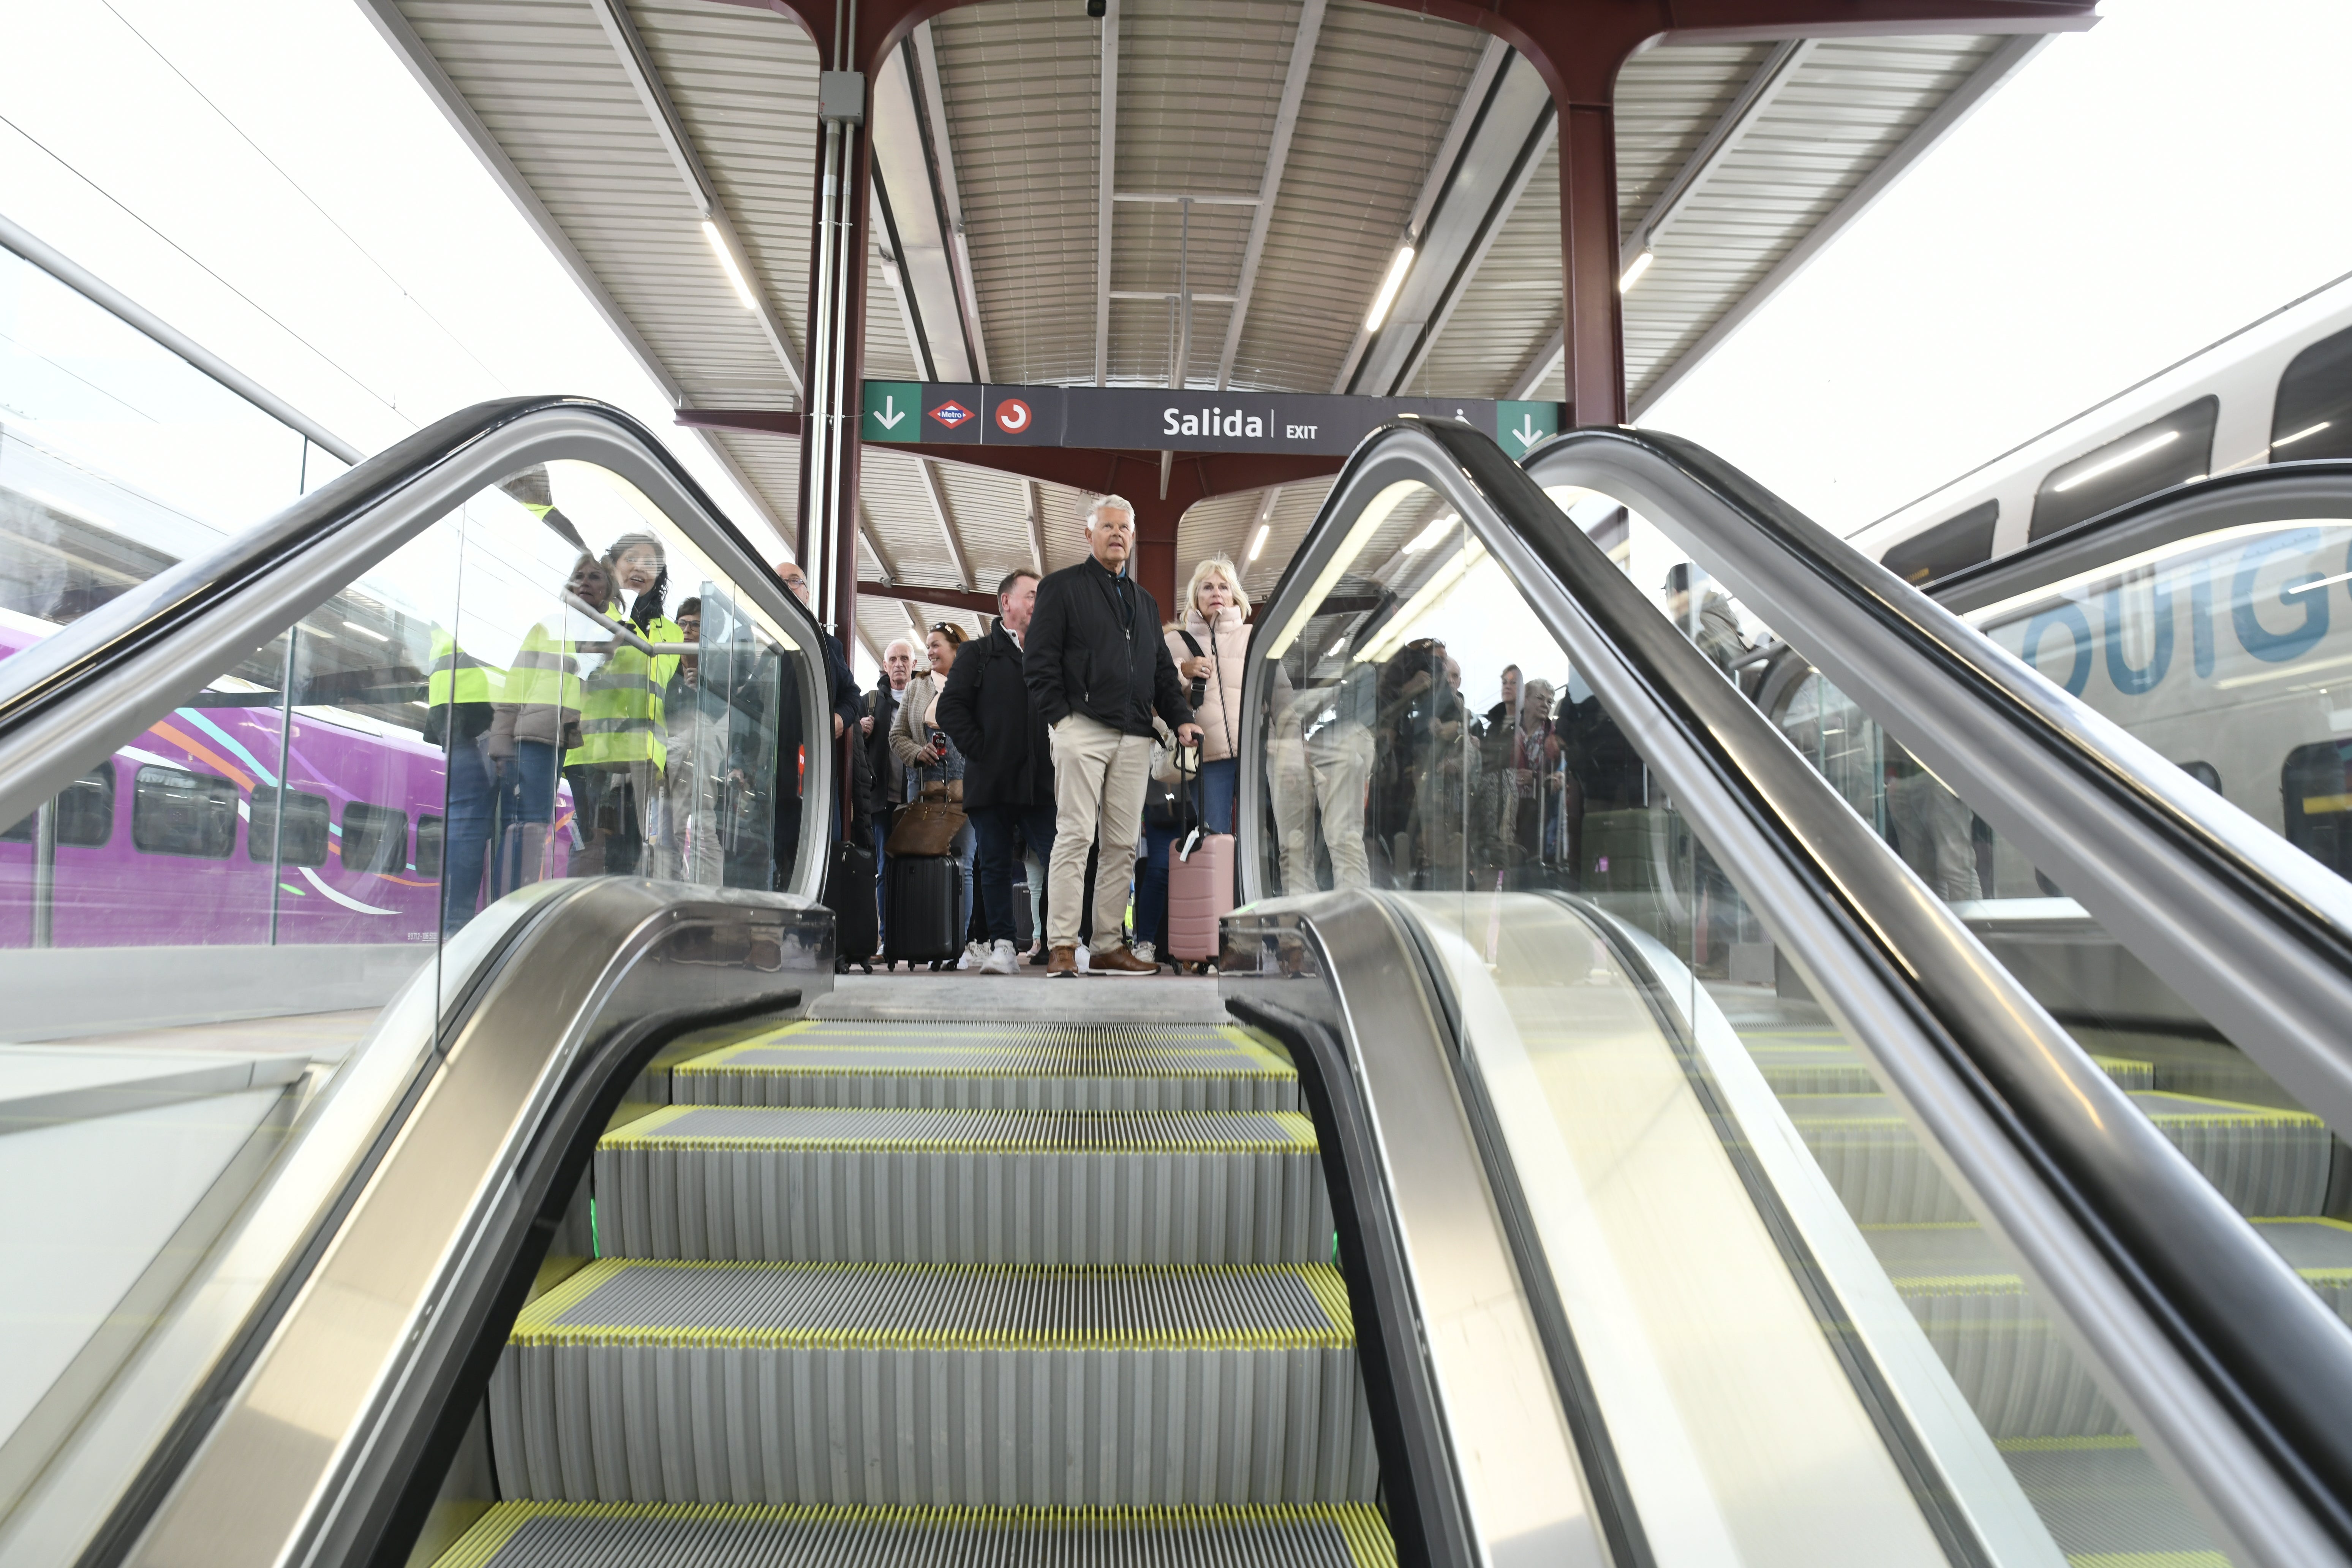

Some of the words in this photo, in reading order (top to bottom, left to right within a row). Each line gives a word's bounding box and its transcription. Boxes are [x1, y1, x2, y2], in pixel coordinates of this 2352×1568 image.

[1163, 407, 1263, 437] Salida
[1286, 425, 1318, 439] EXIT
[2022, 526, 2352, 700] OUIG
